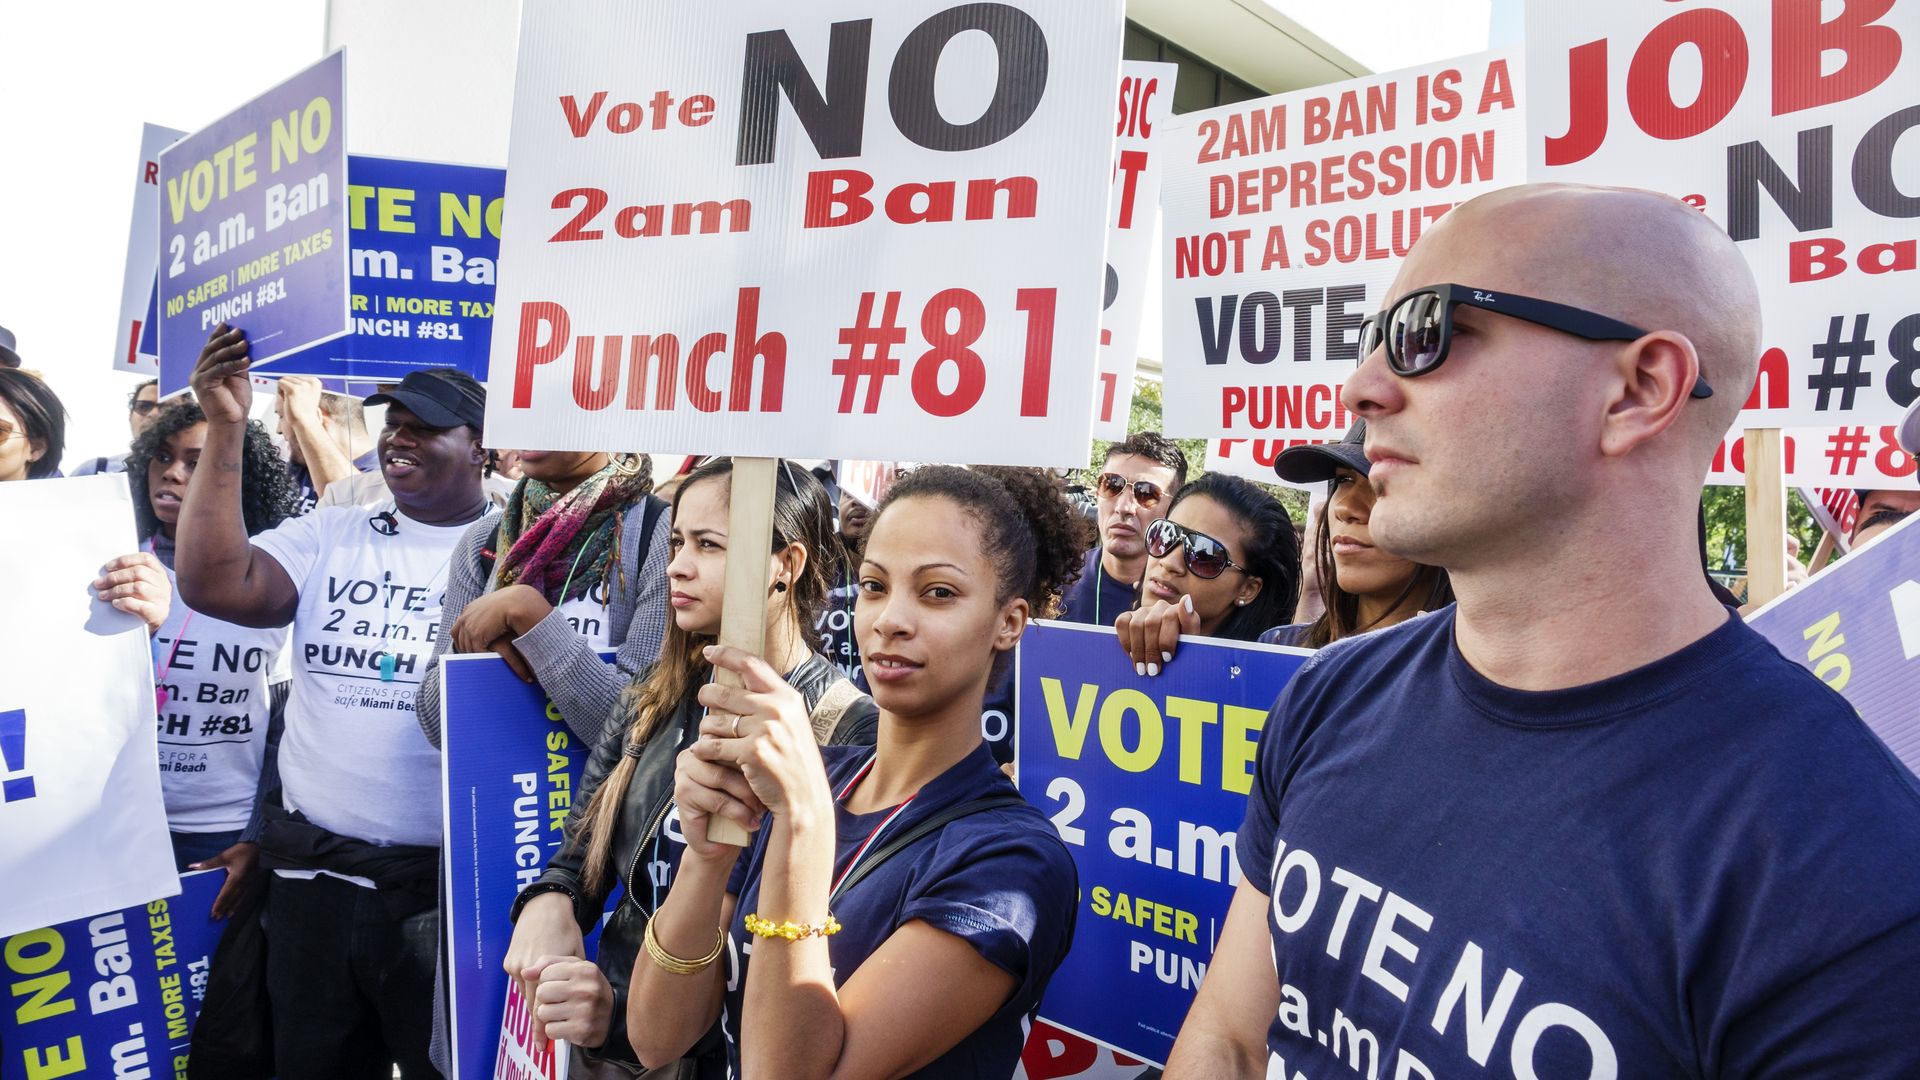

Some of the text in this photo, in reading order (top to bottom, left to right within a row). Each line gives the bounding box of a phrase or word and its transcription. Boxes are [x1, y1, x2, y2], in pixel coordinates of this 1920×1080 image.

[559, 2, 1049, 166] Vote NO
[1197, 58, 1516, 164] 2AM BAN IS A
[167, 96, 332, 225] VOTE NO
[1209, 130, 1496, 219] DEPRESSION
[168, 172, 328, 279] 2 a.m. Ban
[547, 168, 1038, 242] 2am Ban
[1175, 201, 1464, 279] NOT A SOLUT
[166, 228, 333, 318] NO SAFER MORE TAXES
[201, 278, 287, 331] PUNCH #81
[386, 297, 453, 316] MORE
[417, 321, 463, 340] #81
[512, 286, 788, 413] Punch
[831, 287, 1057, 418] #81
[1194, 284, 1366, 365] VOTE
[322, 608, 346, 632] 2
[353, 619, 416, 641] a.m.
[328, 576, 431, 612] VOTE
[212, 643, 263, 673] NO
[304, 643, 417, 674] PUNCH
[337, 684, 388, 697] CITIZENS
[196, 683, 249, 704] Ban
[200, 713, 253, 736] #81
[334, 695, 359, 709] safe
[360, 698, 394, 709] Miami
[170, 752, 196, 761] FOR
[174, 762, 206, 772] Beach
[1040, 677, 1270, 795] VOTE
[546, 731, 570, 832] SAFER
[1045, 777, 1085, 847] 2
[512, 772, 541, 893] PUNCH
[147, 899, 177, 970] TAXES
[1091, 886, 1199, 944] SAFER
[4, 927, 76, 1025] NO
[88, 912, 139, 1015] Ban
[187, 955, 210, 1001] #81
[159, 973, 189, 1039] MORE
